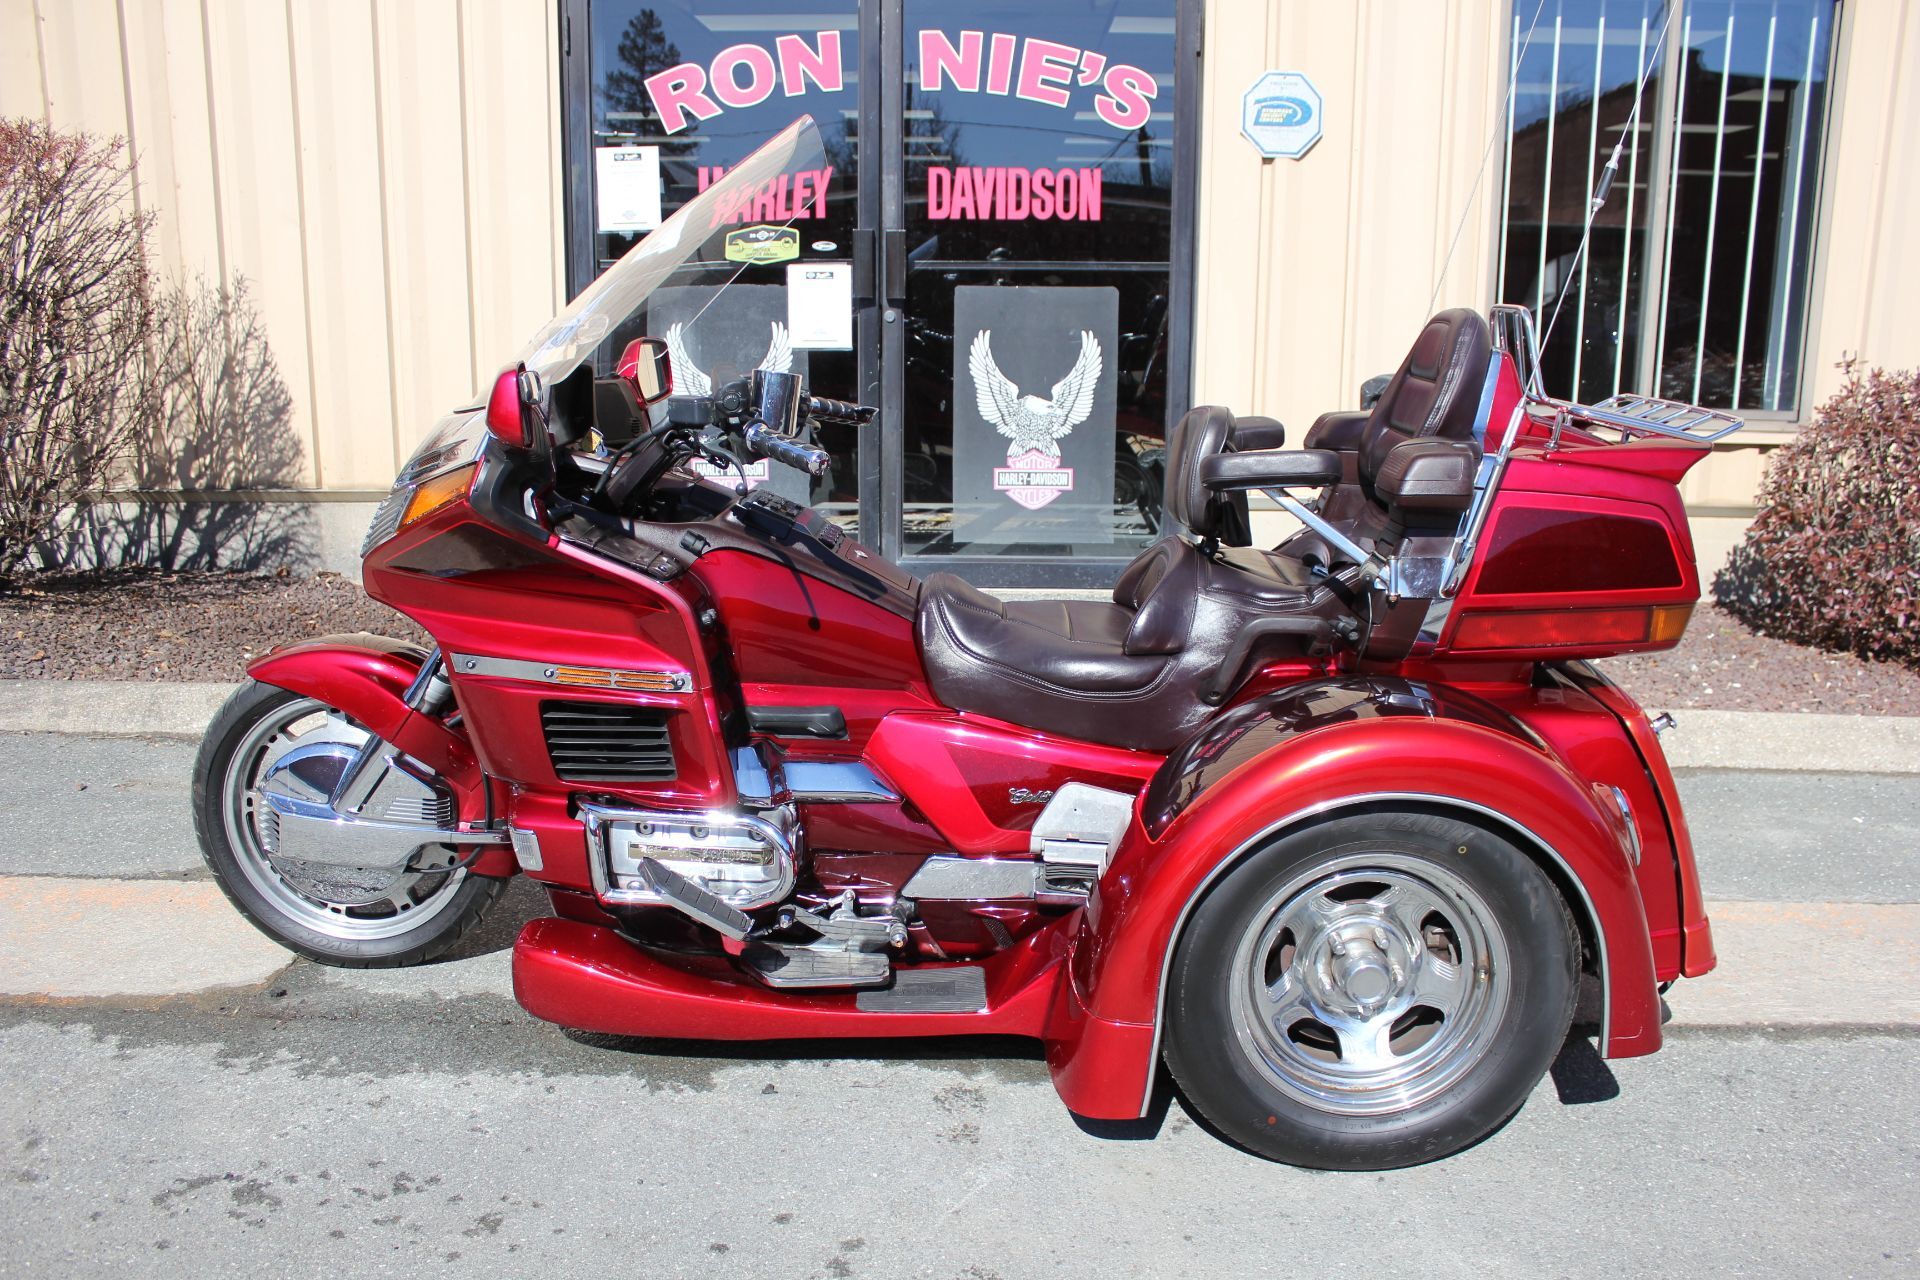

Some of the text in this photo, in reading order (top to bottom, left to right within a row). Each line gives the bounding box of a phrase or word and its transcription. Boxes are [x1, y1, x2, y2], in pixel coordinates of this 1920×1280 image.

[644, 29, 1159, 134] RON NIE'S
[698, 166, 1102, 228] HARLEY DAVIDSON
[999, 472, 1068, 486] HARLEY-DAVIDSON
